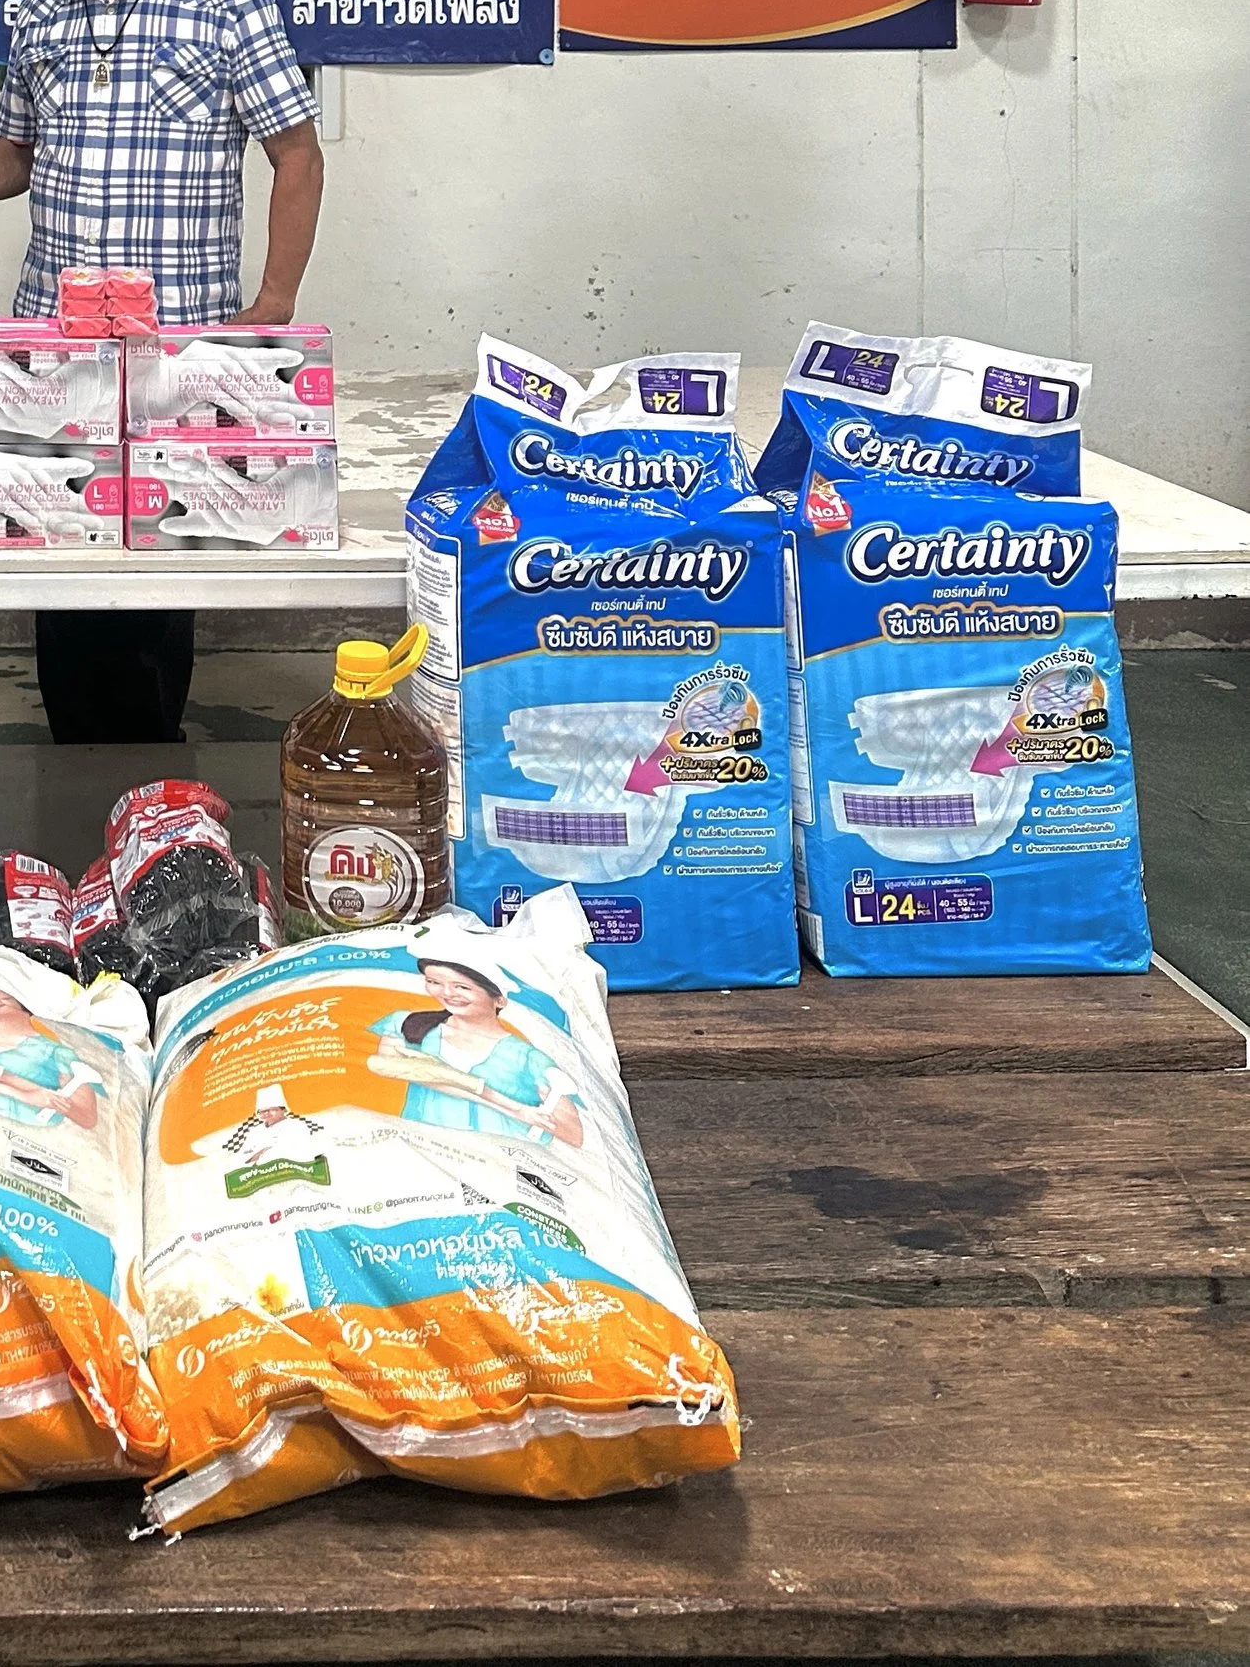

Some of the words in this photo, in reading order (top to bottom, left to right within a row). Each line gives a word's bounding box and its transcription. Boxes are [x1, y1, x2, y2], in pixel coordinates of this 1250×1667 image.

[812, 345, 839, 379] L
[852, 351, 883, 368] 24
[178, 374, 211, 383] LATEX
[244, 383, 280, 392] GLOVES
[489, 356, 520, 398] L
[524, 374, 554, 401] 24
[34, 396, 67, 405] LATEX
[652, 389, 681, 414] 24
[690, 374, 718, 413] L
[995, 393, 1025, 417] 24
[514, 433, 704, 496] Certainty
[832, 423, 1036, 487] Certainty
[35, 494, 71, 502] GLOVES
[149, 496, 162, 508] M
[183, 492, 218, 500] GLOVES
[252, 502, 285, 510] LATEX
[806, 495, 848, 520] No.1
[849, 524, 1090, 585] Certainty
[512, 540, 747, 602] Certainty
[888, 608, 960, 635] ซึมซับดี
[965, 609, 1057, 634] แห้งสบาย
[546, 622, 617, 648] ซึมซับดี
[621, 623, 712, 648] แห้งสบาย
[1008, 645, 1094, 703] ป้องกันการรั่วซึม
[662, 661, 749, 720] ป้องกันการรั่วซึม
[1026, 713, 1076, 729] 4Xtra
[1080, 712, 1105, 726] Lock
[679, 731, 729, 747] 4Xtra
[733, 732, 759, 746] Lock
[1064, 737, 1112, 761] 20%
[717, 757, 766, 781] 20%
[854, 896, 873, 923] L
[881, 893, 916, 922] 24
[326, 949, 392, 961] 100%
[516, 1205, 568, 1233] CONSTANT
